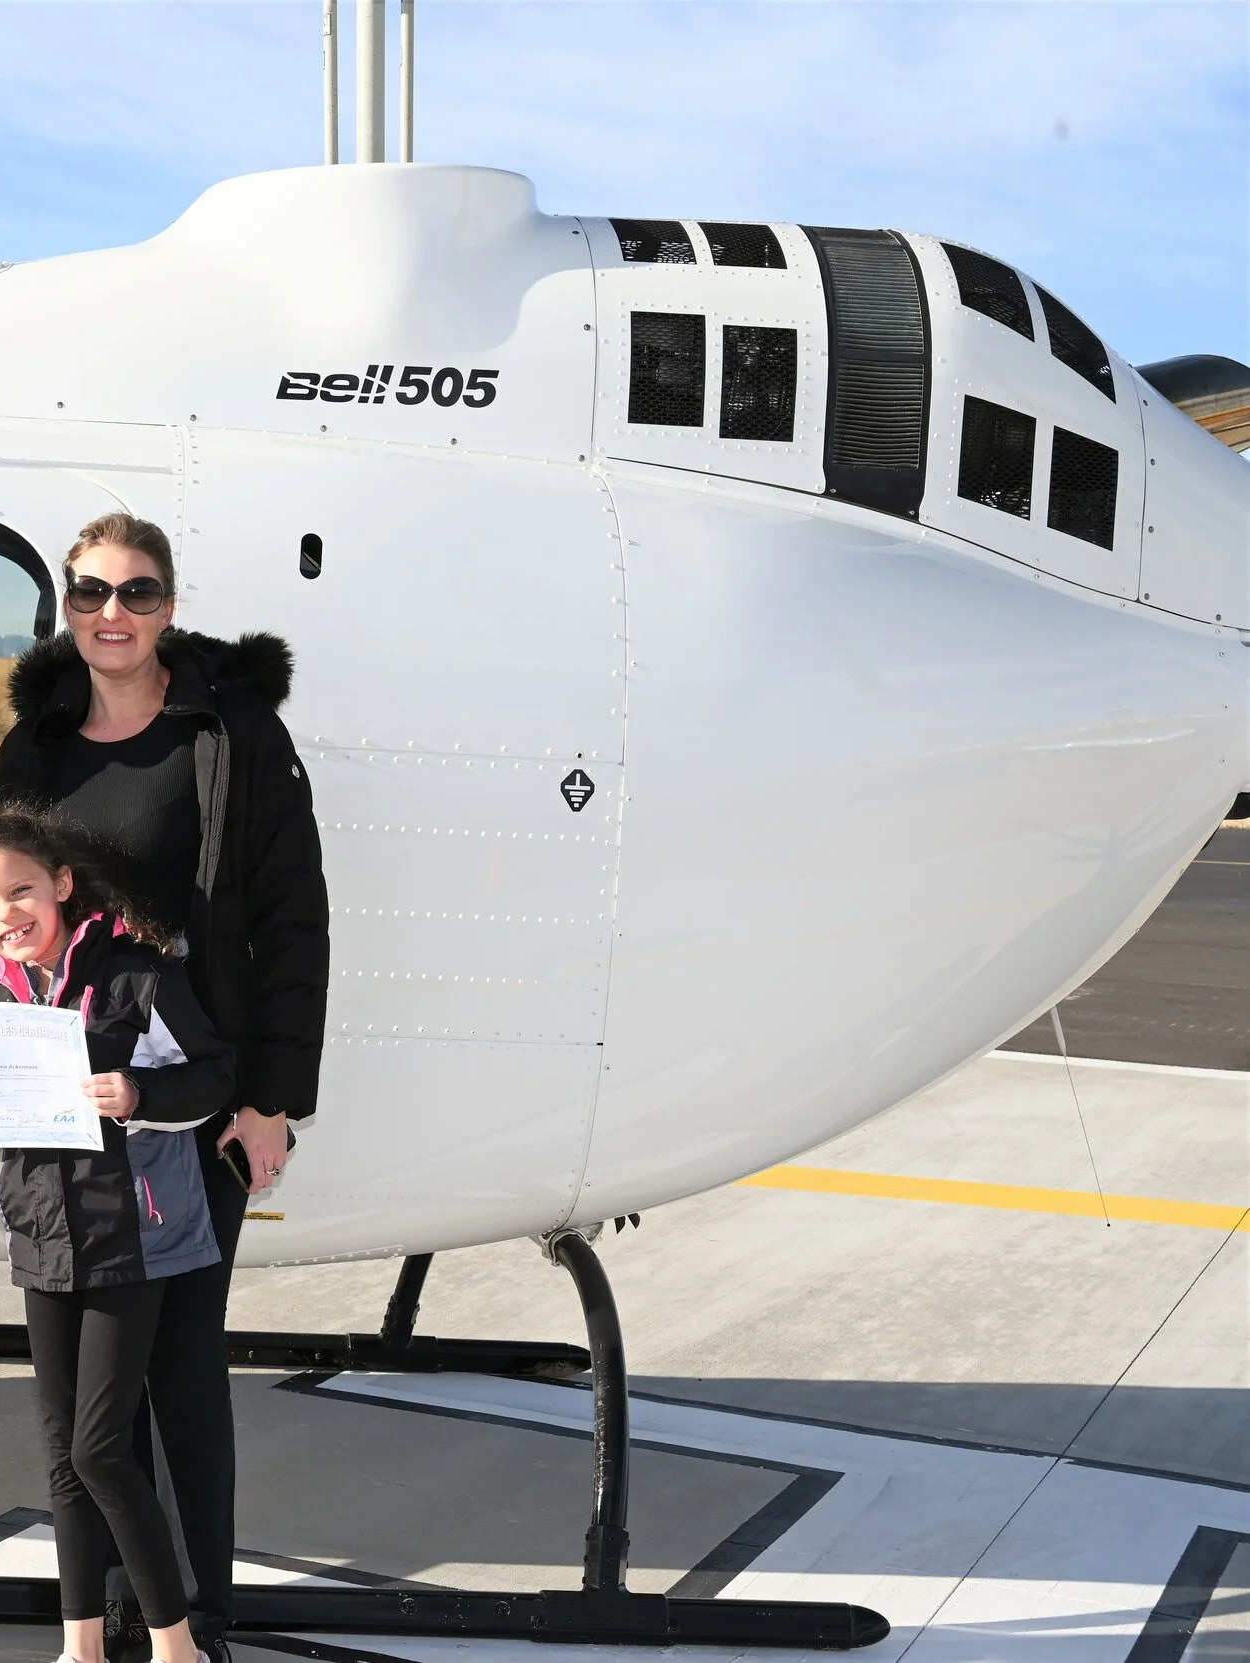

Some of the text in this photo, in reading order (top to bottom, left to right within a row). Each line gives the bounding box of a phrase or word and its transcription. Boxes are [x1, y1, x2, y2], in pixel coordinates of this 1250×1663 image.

[276, 365, 500, 408] Bell 505
[18, 1026, 69, 1042] CERTIFICATE
[53, 1114, 76, 1123] EAA
